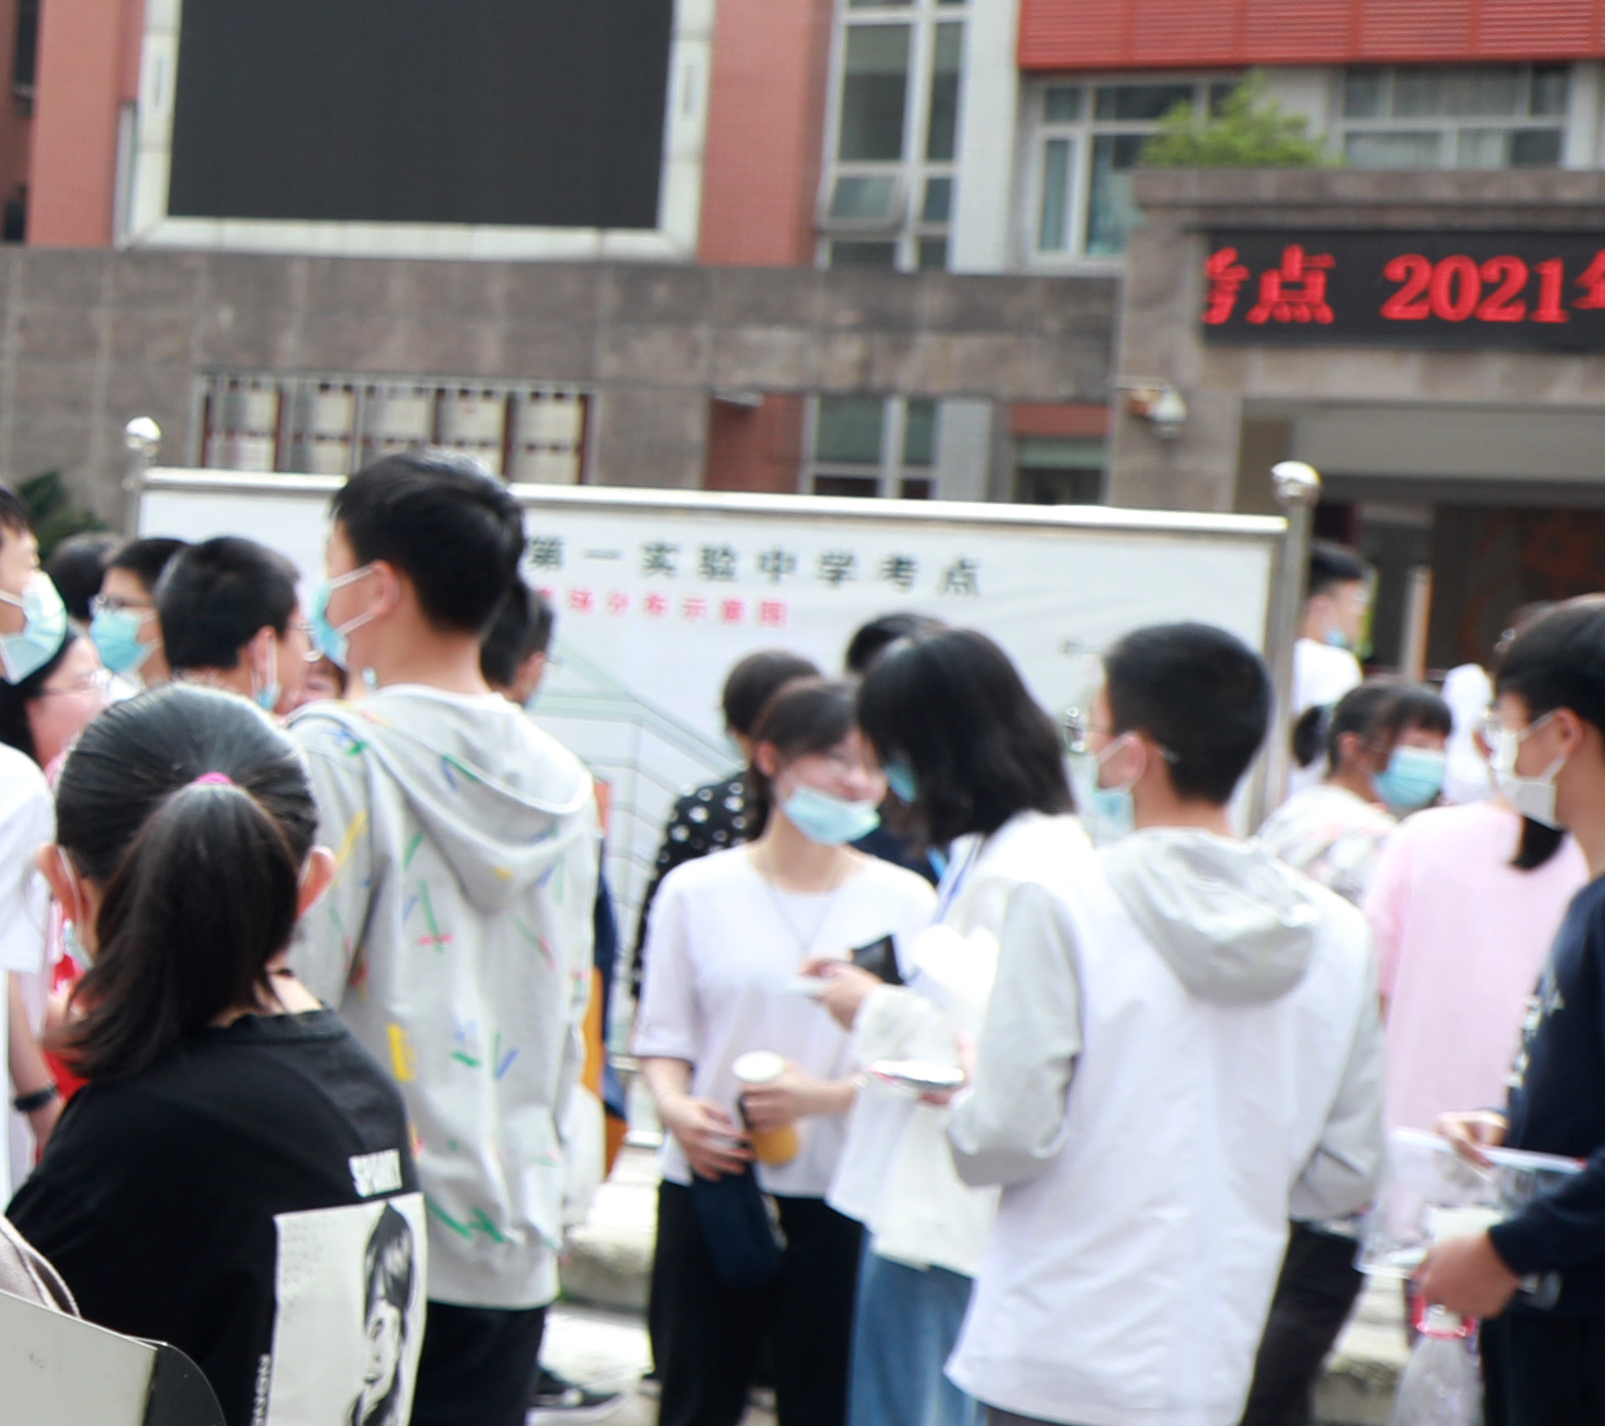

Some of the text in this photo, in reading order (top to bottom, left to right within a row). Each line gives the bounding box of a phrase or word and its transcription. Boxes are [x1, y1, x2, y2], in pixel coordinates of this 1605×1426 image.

[526, 535, 984, 598] 第一实验中学考点
[539, 586, 791, 628] 场分布示意图
